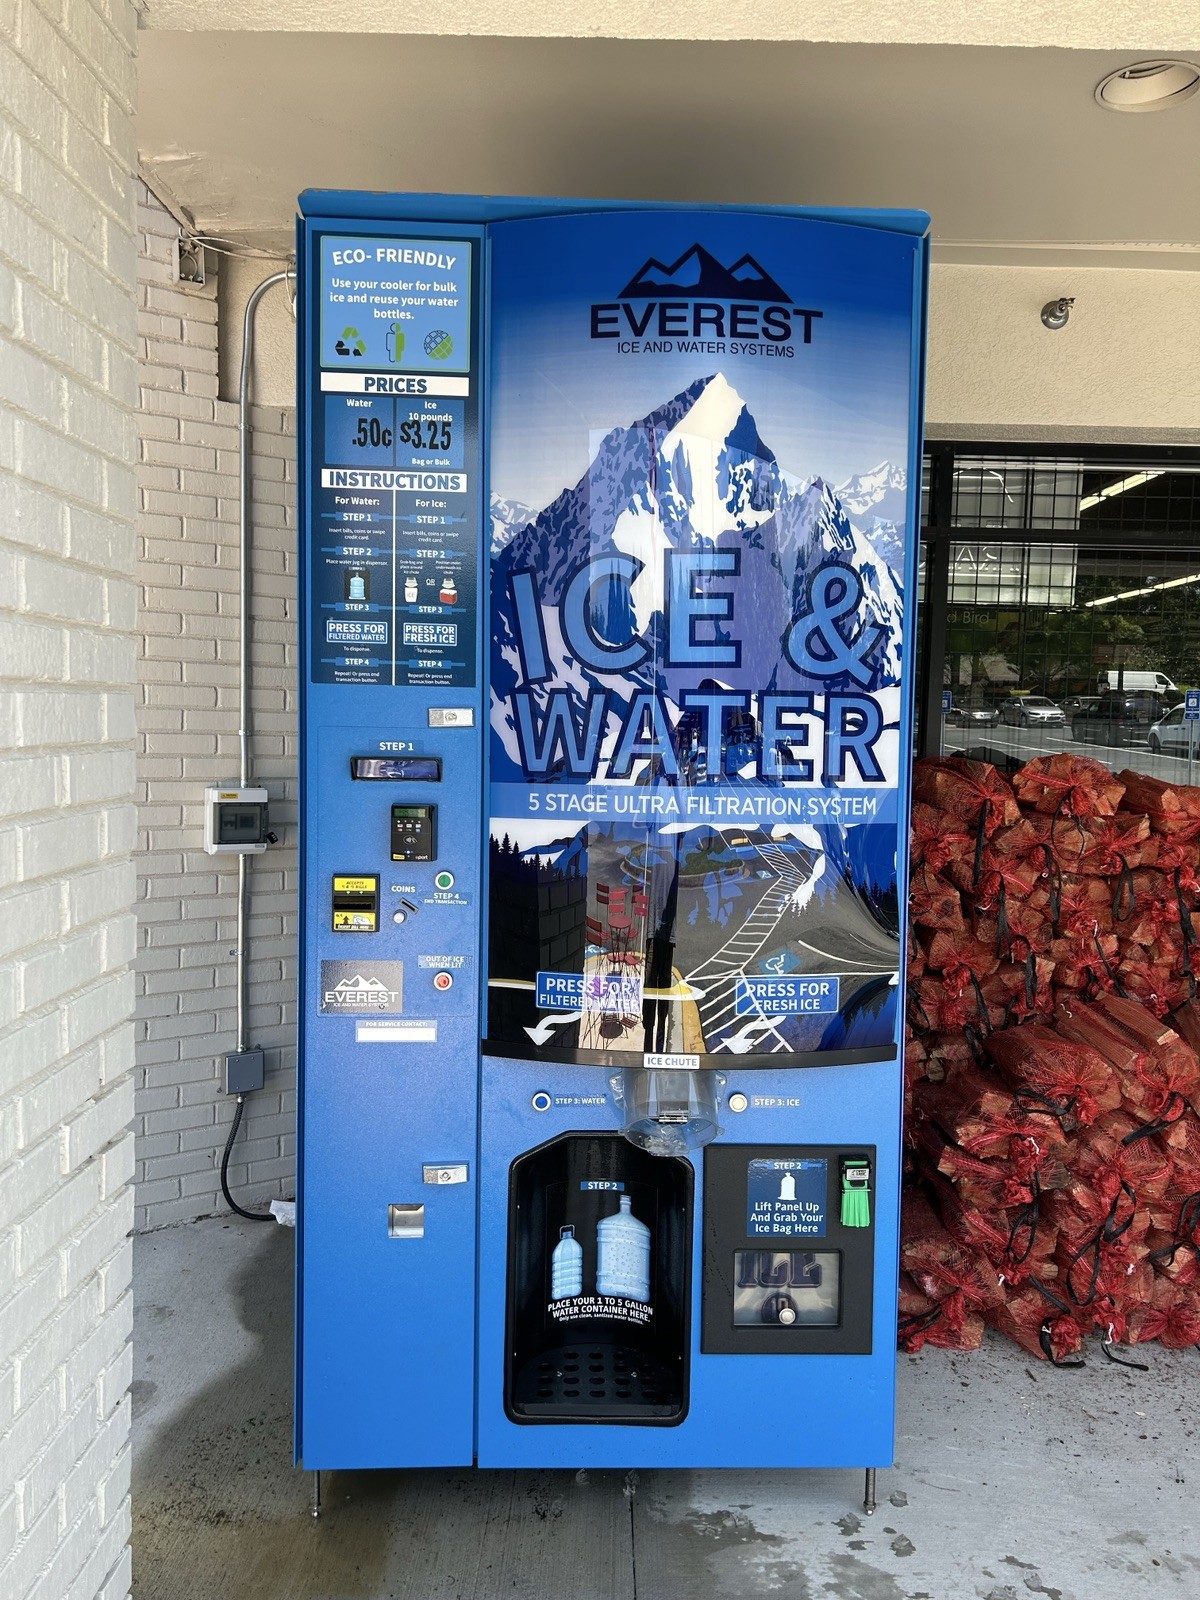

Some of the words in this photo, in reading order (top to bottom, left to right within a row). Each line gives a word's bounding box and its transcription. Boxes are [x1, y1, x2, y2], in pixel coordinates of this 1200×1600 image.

[332, 249, 372, 266] ECO-
[376, 248, 456, 270] FRIENDLY
[332, 278, 351, 288] Use
[353, 280, 378, 290] your
[380, 280, 412, 290] cooler
[416, 281, 431, 290] for
[434, 282, 457, 292] bulk
[330, 292, 344, 302] ice
[348, 294, 367, 303] and
[370, 296, 398, 304] reuse
[401, 297, 425, 306] your
[428, 298, 458, 306] water
[374, 309, 415, 319] bottles.
[590, 303, 823, 344] EVEREST
[617, 342, 640, 354] ICE
[643, 341, 672, 353] AND
[677, 341, 726, 353] WATER
[730, 342, 795, 358] SYSTEMS
[364, 377, 427, 393] PRICES
[346, 399, 372, 408] Water
[424, 401, 437, 409] Ice
[408, 413, 418, 421] 10
[421, 413, 453, 422] pounds
[400, 419, 451, 450] $3.25
[412, 458, 425, 466] Bag
[435, 458, 450, 466] Bulk
[329, 471, 460, 490] INSTRUCTIONS
[335, 496, 349, 504] For
[351, 497, 380, 505] Water:
[416, 499, 429, 507] For
[430, 500, 447, 508] Ice:
[343, 513, 365, 521] STEP
[417, 515, 438, 524] STEP
[440, 516, 446, 524] 1
[343, 547, 365, 555] STEP
[366, 548, 372, 556] 2
[417, 550, 438, 558] STEP
[438, 606, 443, 614] 3
[506, 548, 742, 685] ICE
[784, 560, 889, 692] &
[963, 610, 989, 624] Bird
[329, 623, 361, 633] PRESS
[364, 624, 384, 633] FOR
[406, 625, 434, 633] PRESS
[436, 626, 454, 634] FOR
[405, 634, 437, 642] FRESH
[440, 635, 455, 643] ICE
[510, 687, 887, 782] WATER
[379, 742, 405, 751] STEP
[408, 742, 414, 751] 1
[528, 792, 540, 810] 5
[545, 793, 607, 812] STAGE
[614, 795, 680, 814] ULTRA
[687, 796, 801, 816] FILTRATION
[807, 798, 877, 816] SYSTEM
[546, 978, 595, 993] PRESS
[600, 982, 632, 994] FOR
[747, 984, 795, 997] PRESS
[800, 982, 830, 996] FOR
[325, 992, 398, 1002] EVEREST
[540, 994, 592, 1007] FILTERED
[598, 998, 639, 1010] WATER
[756, 1000, 797, 1011] FRESH
[800, 999, 820, 1010] ICE
[647, 1057, 663, 1066] ICE
[664, 1057, 697, 1067] CHUTE
[581, 1097, 606, 1105] WATER
[754, 1098, 775, 1106] STEP
[787, 1099, 800, 1107] ICE
[796, 1162, 802, 1170] 2
[588, 1182, 611, 1190] STEP
[612, 1182, 618, 1190] 2
[755, 1202, 772, 1211] Lift
[775, 1202, 803, 1211] Panel
[806, 1202, 820, 1214] Up
[750, 1213, 770, 1222] And
[773, 1213, 798, 1222] Grab
[800, 1213, 824, 1222] Your
[755, 1224, 770, 1232] Ice
[773, 1224, 792, 1235] Bag
[794, 1224, 819, 1232] Here
[548, 1298, 571, 1312] PLACE
[573, 1297, 595, 1305] YOUR
[605, 1297, 615, 1305] TO
[625, 1300, 653, 1315] GALLON
[552, 1306, 579, 1318] WATER
[581, 1305, 628, 1315] CONTAINER
[630, 1310, 650, 1322] HERE.
